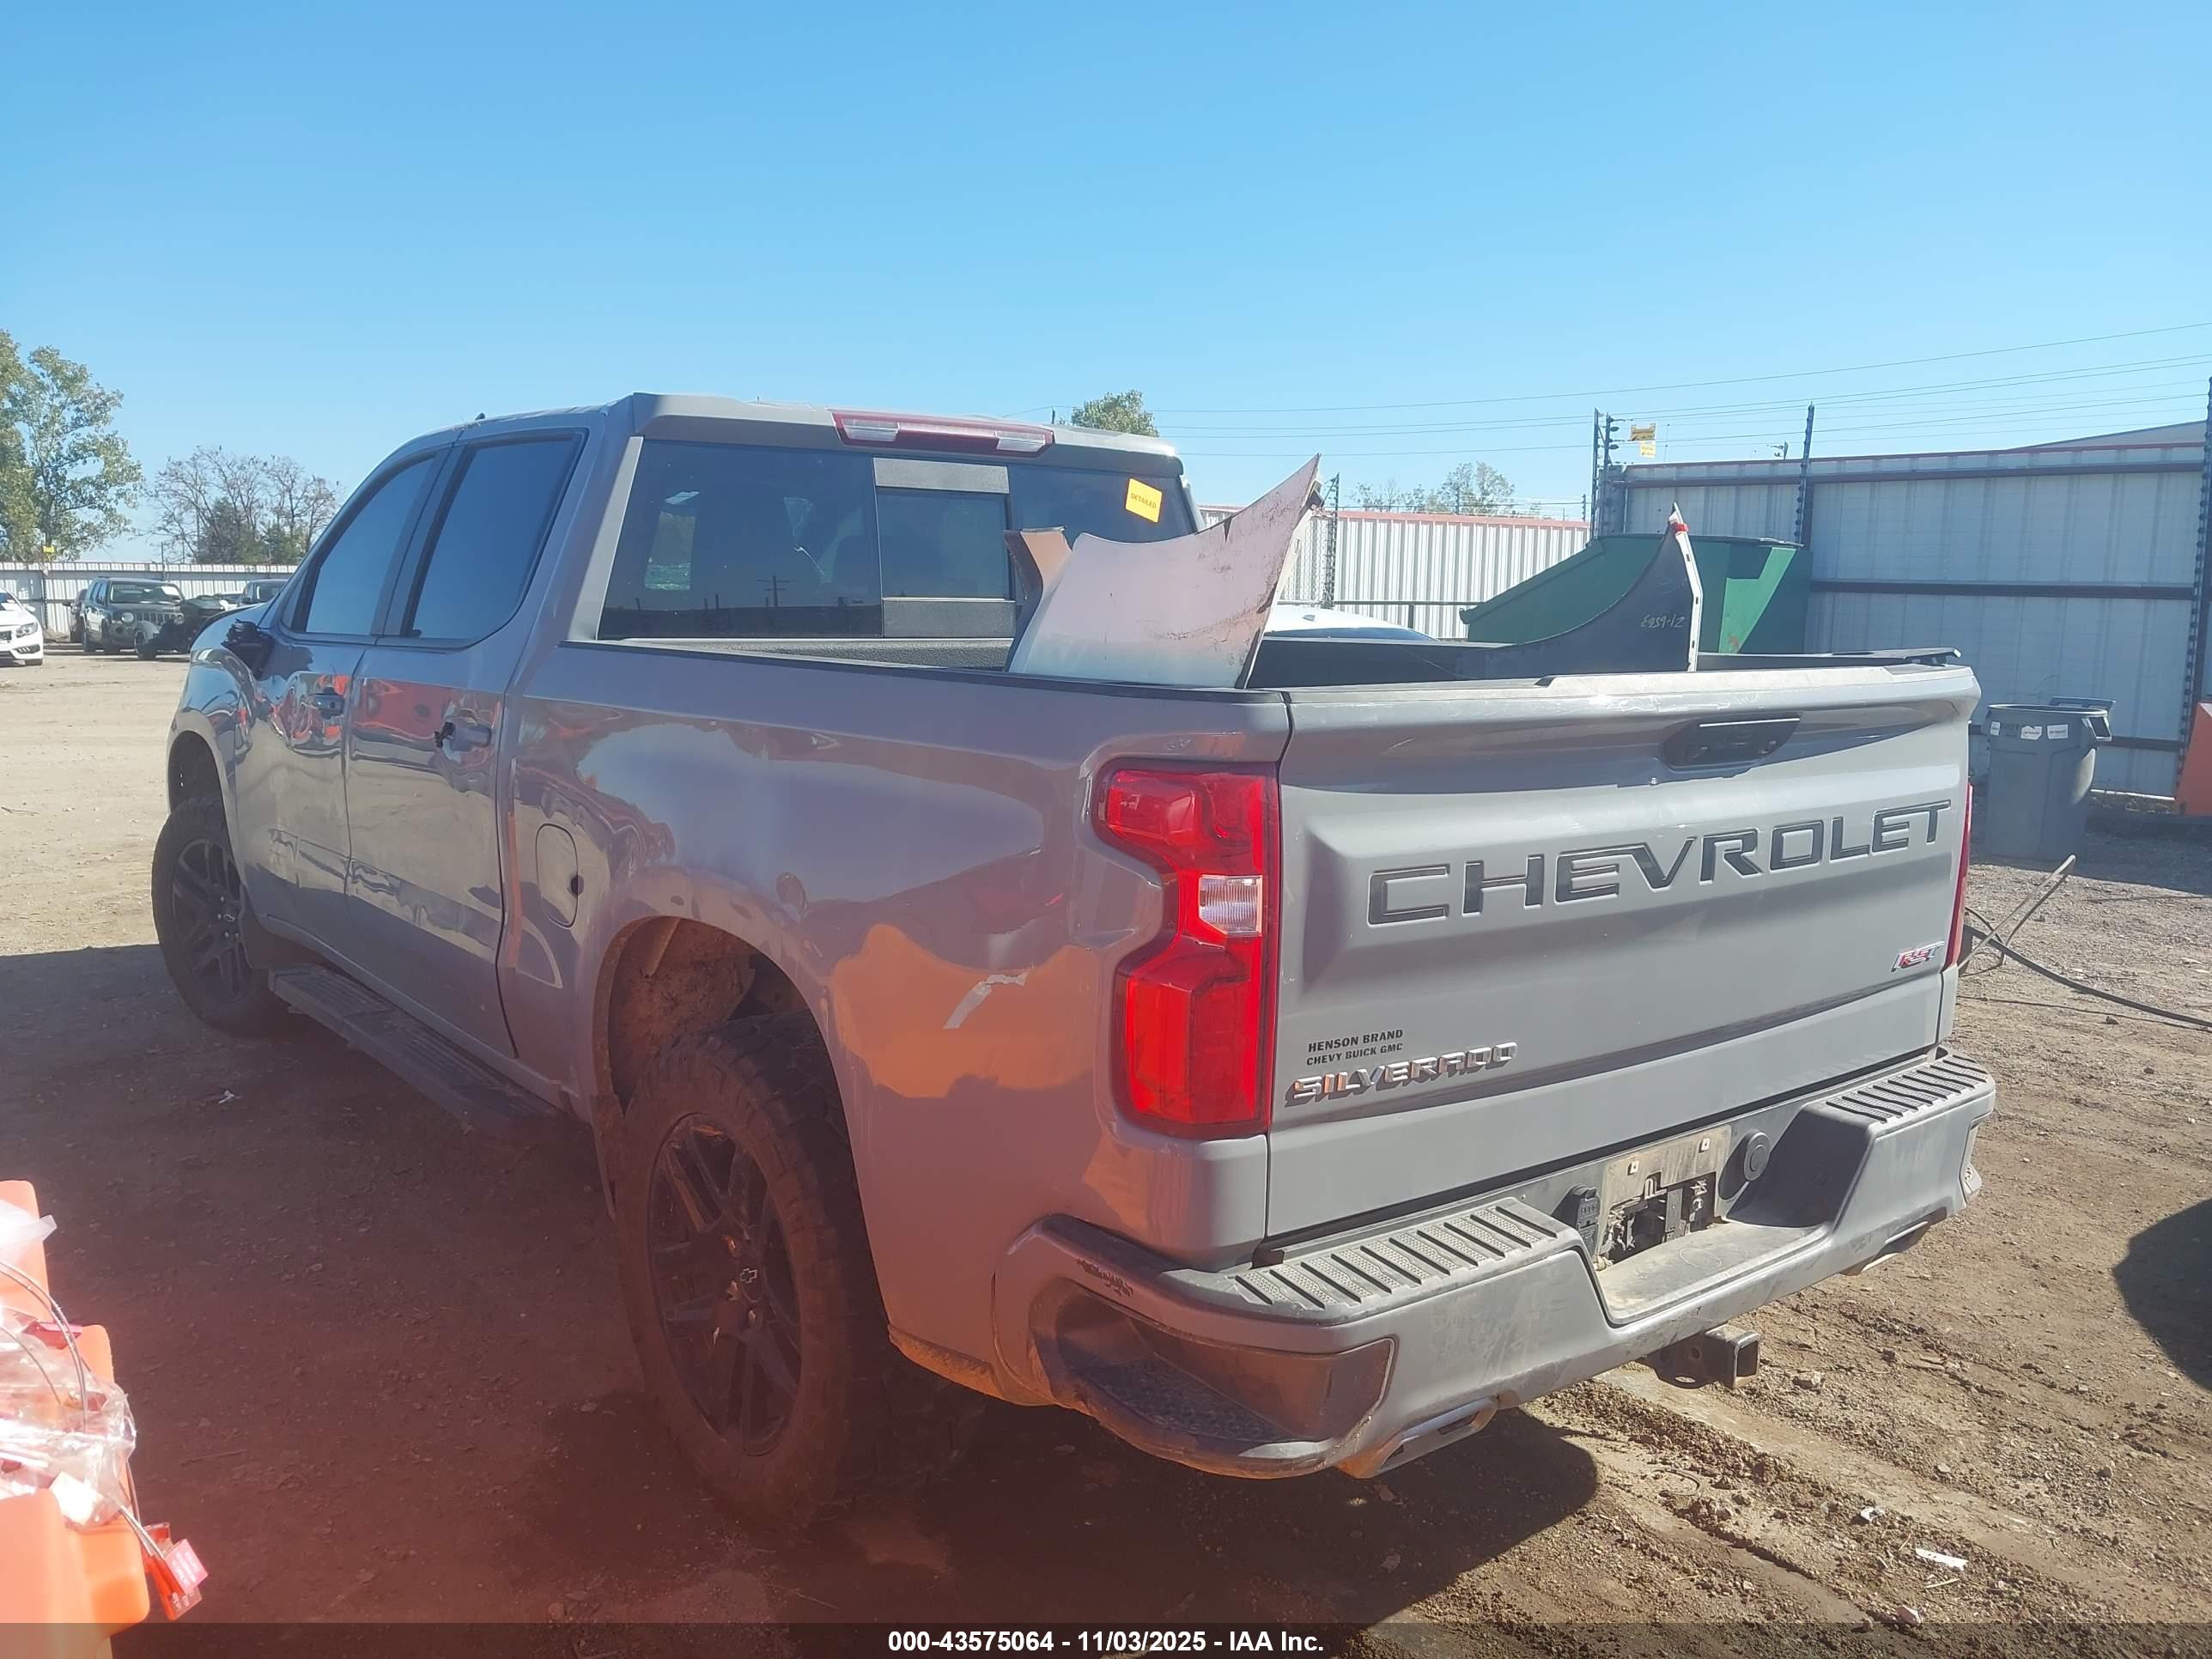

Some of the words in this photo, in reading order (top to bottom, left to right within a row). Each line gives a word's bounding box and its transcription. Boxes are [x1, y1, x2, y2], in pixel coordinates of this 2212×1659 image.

[1367, 799, 1952, 927] CHEVROLET
[1892, 940, 1945, 970] RST
[1306, 1053, 1342, 1066] CHEVY
[1346, 1046, 1377, 1060] BUICK
[1380, 1042, 1403, 1054] GMC
[1308, 1036, 1359, 1053] HENSON
[1363, 1029, 1403, 1043] BRAND
[1293, 1042, 1518, 1099] SILVERADO
